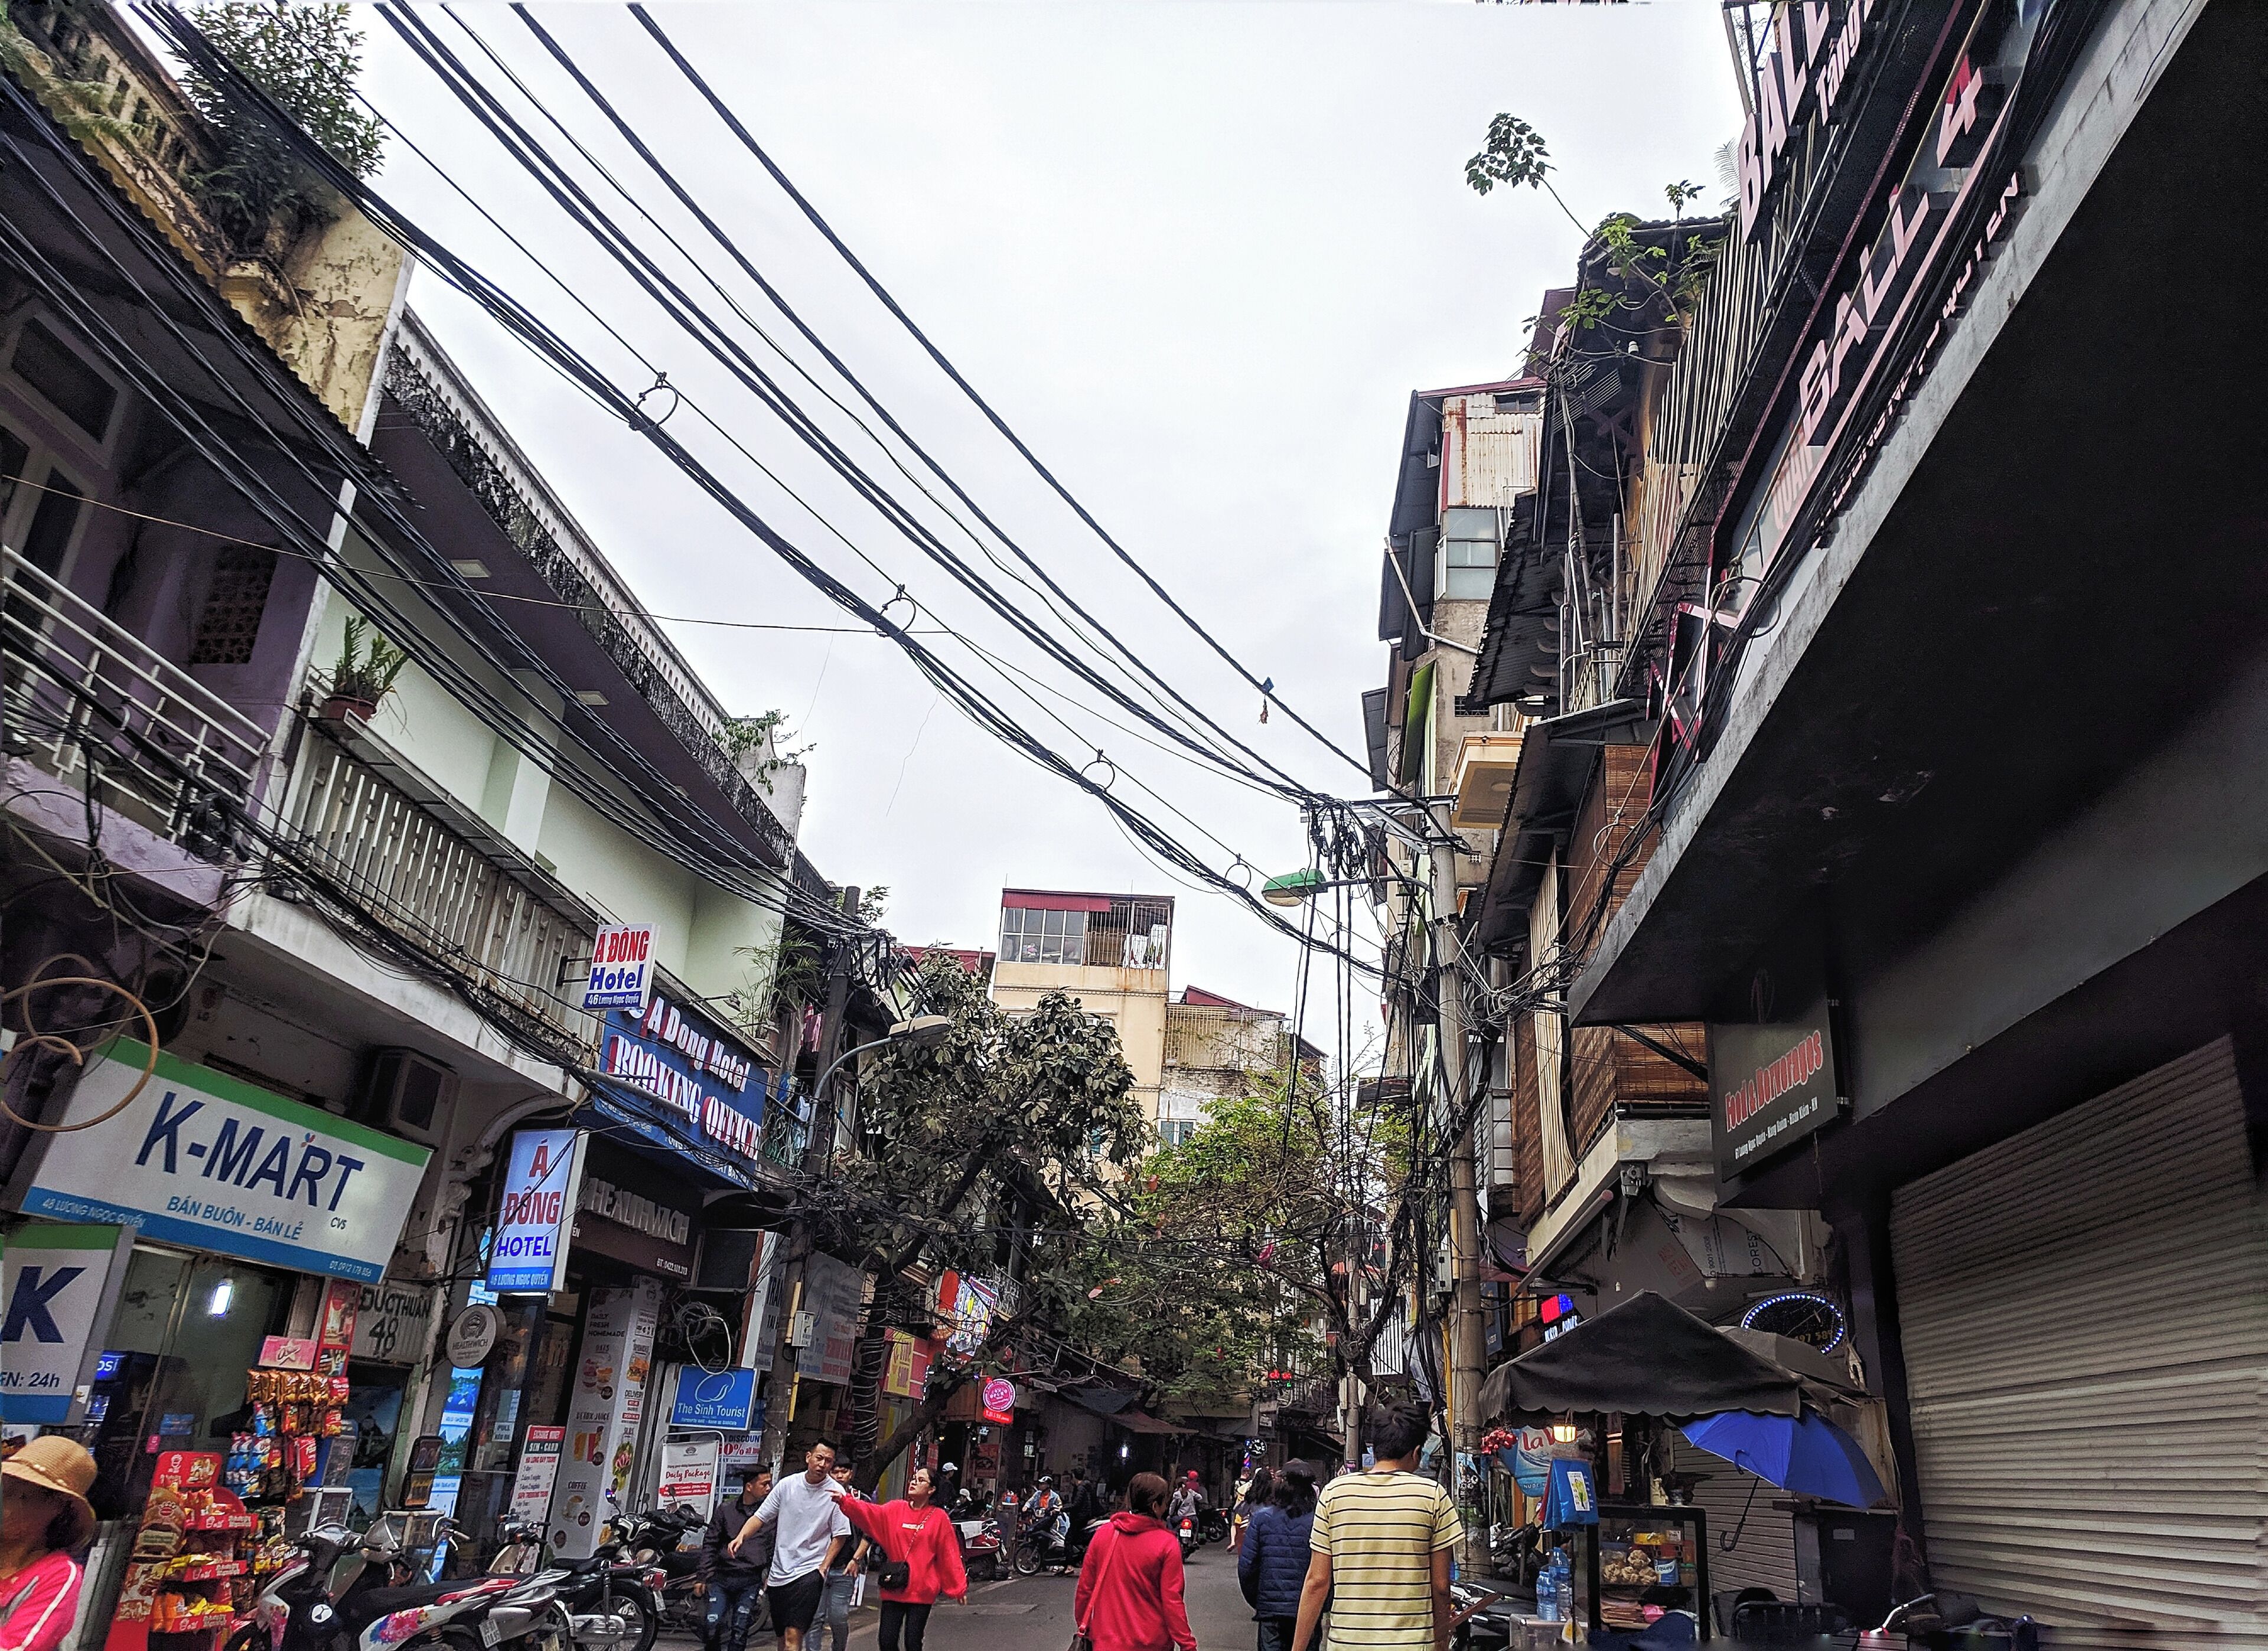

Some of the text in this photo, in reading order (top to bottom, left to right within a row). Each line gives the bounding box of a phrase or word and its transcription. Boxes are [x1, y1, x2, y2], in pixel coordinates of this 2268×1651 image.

[1798, 183, 1929, 447] BALL
[593, 927, 650, 962] Á ĐÔNG
[589, 964, 644, 990] Hotel
[588, 994, 599, 1004] 46
[647, 996, 751, 1093] A Dong Hotel
[610, 1035, 702, 1124] BOOKING
[703, 1095, 762, 1161] OFFICE
[135, 1091, 365, 1212] K-MART
[504, 1138, 561, 1225] Á ĐÔNG
[167, 1195, 203, 1216] BÁN
[202, 1203, 246, 1227] BUÔN
[253, 1216, 282, 1236] BÁN
[286, 1221, 304, 1241] LẺ
[330, 1216, 347, 1230] CVS
[496, 1236, 552, 1257] HOTEL
[1, 1266, 87, 1344] K
[369, 1316, 399, 1358] 48
[30, 1372, 60, 1388] 24h
[678, 1403, 745, 1418] The Sinh Tourist
[568, 1480, 587, 1490] COFFEE
[666, 1469, 711, 1482] Daily Package
